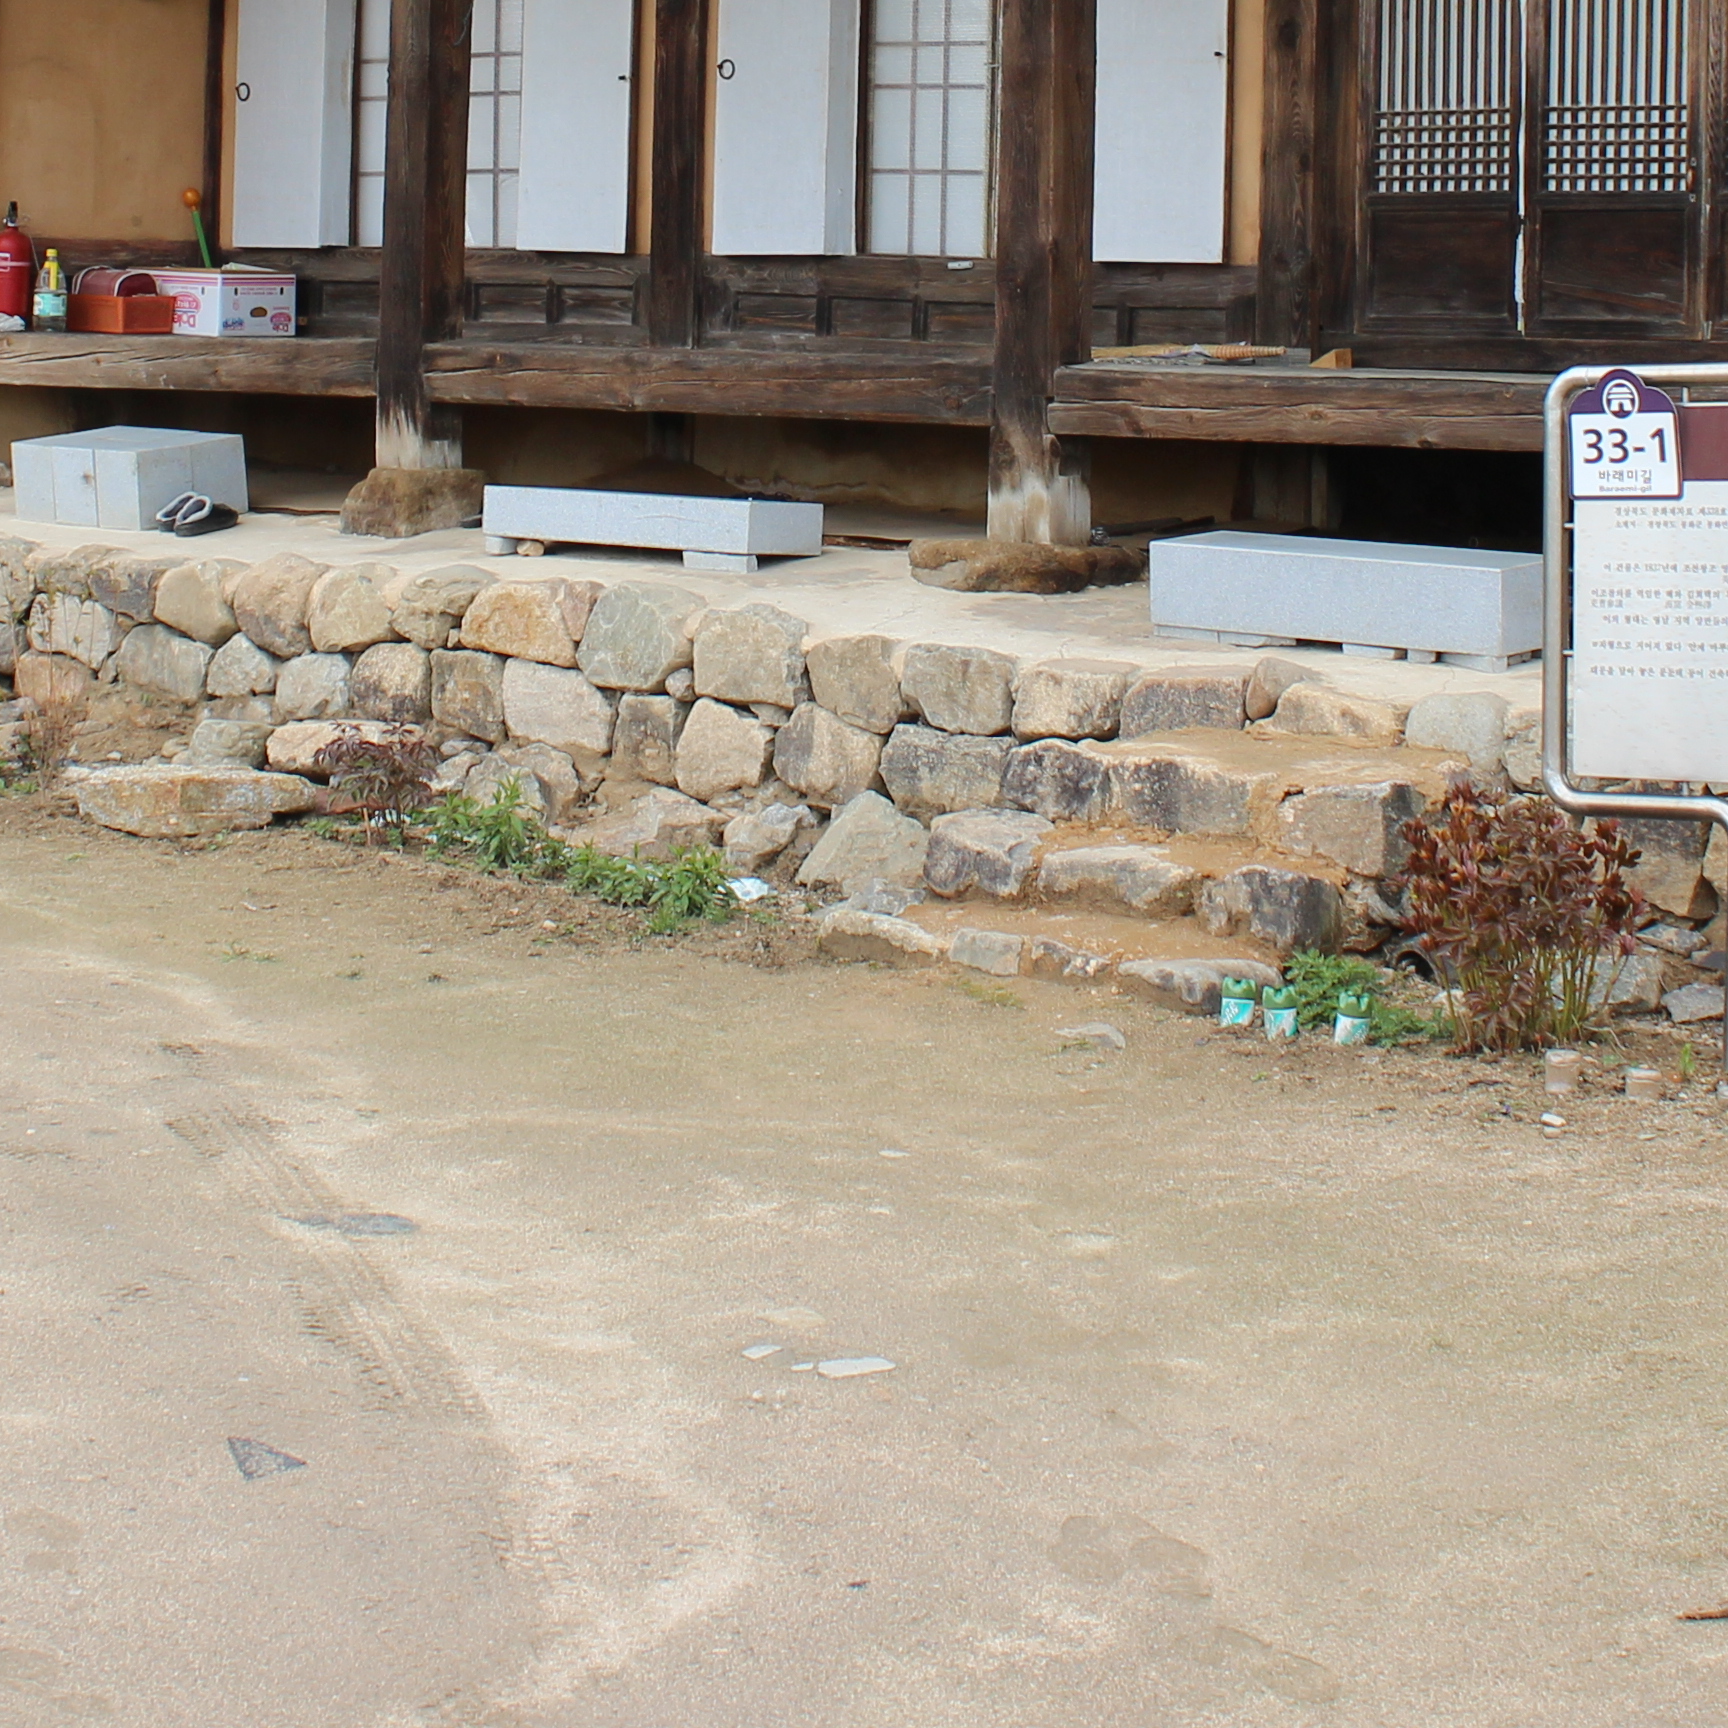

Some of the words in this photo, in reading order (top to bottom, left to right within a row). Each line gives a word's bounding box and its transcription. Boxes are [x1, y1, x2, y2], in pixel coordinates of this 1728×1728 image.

[1582, 428, 1668, 464] 33-1
[1598, 469, 1652, 484] 바래미길
[1599, 485, 1652, 493] Baraemi-gil
